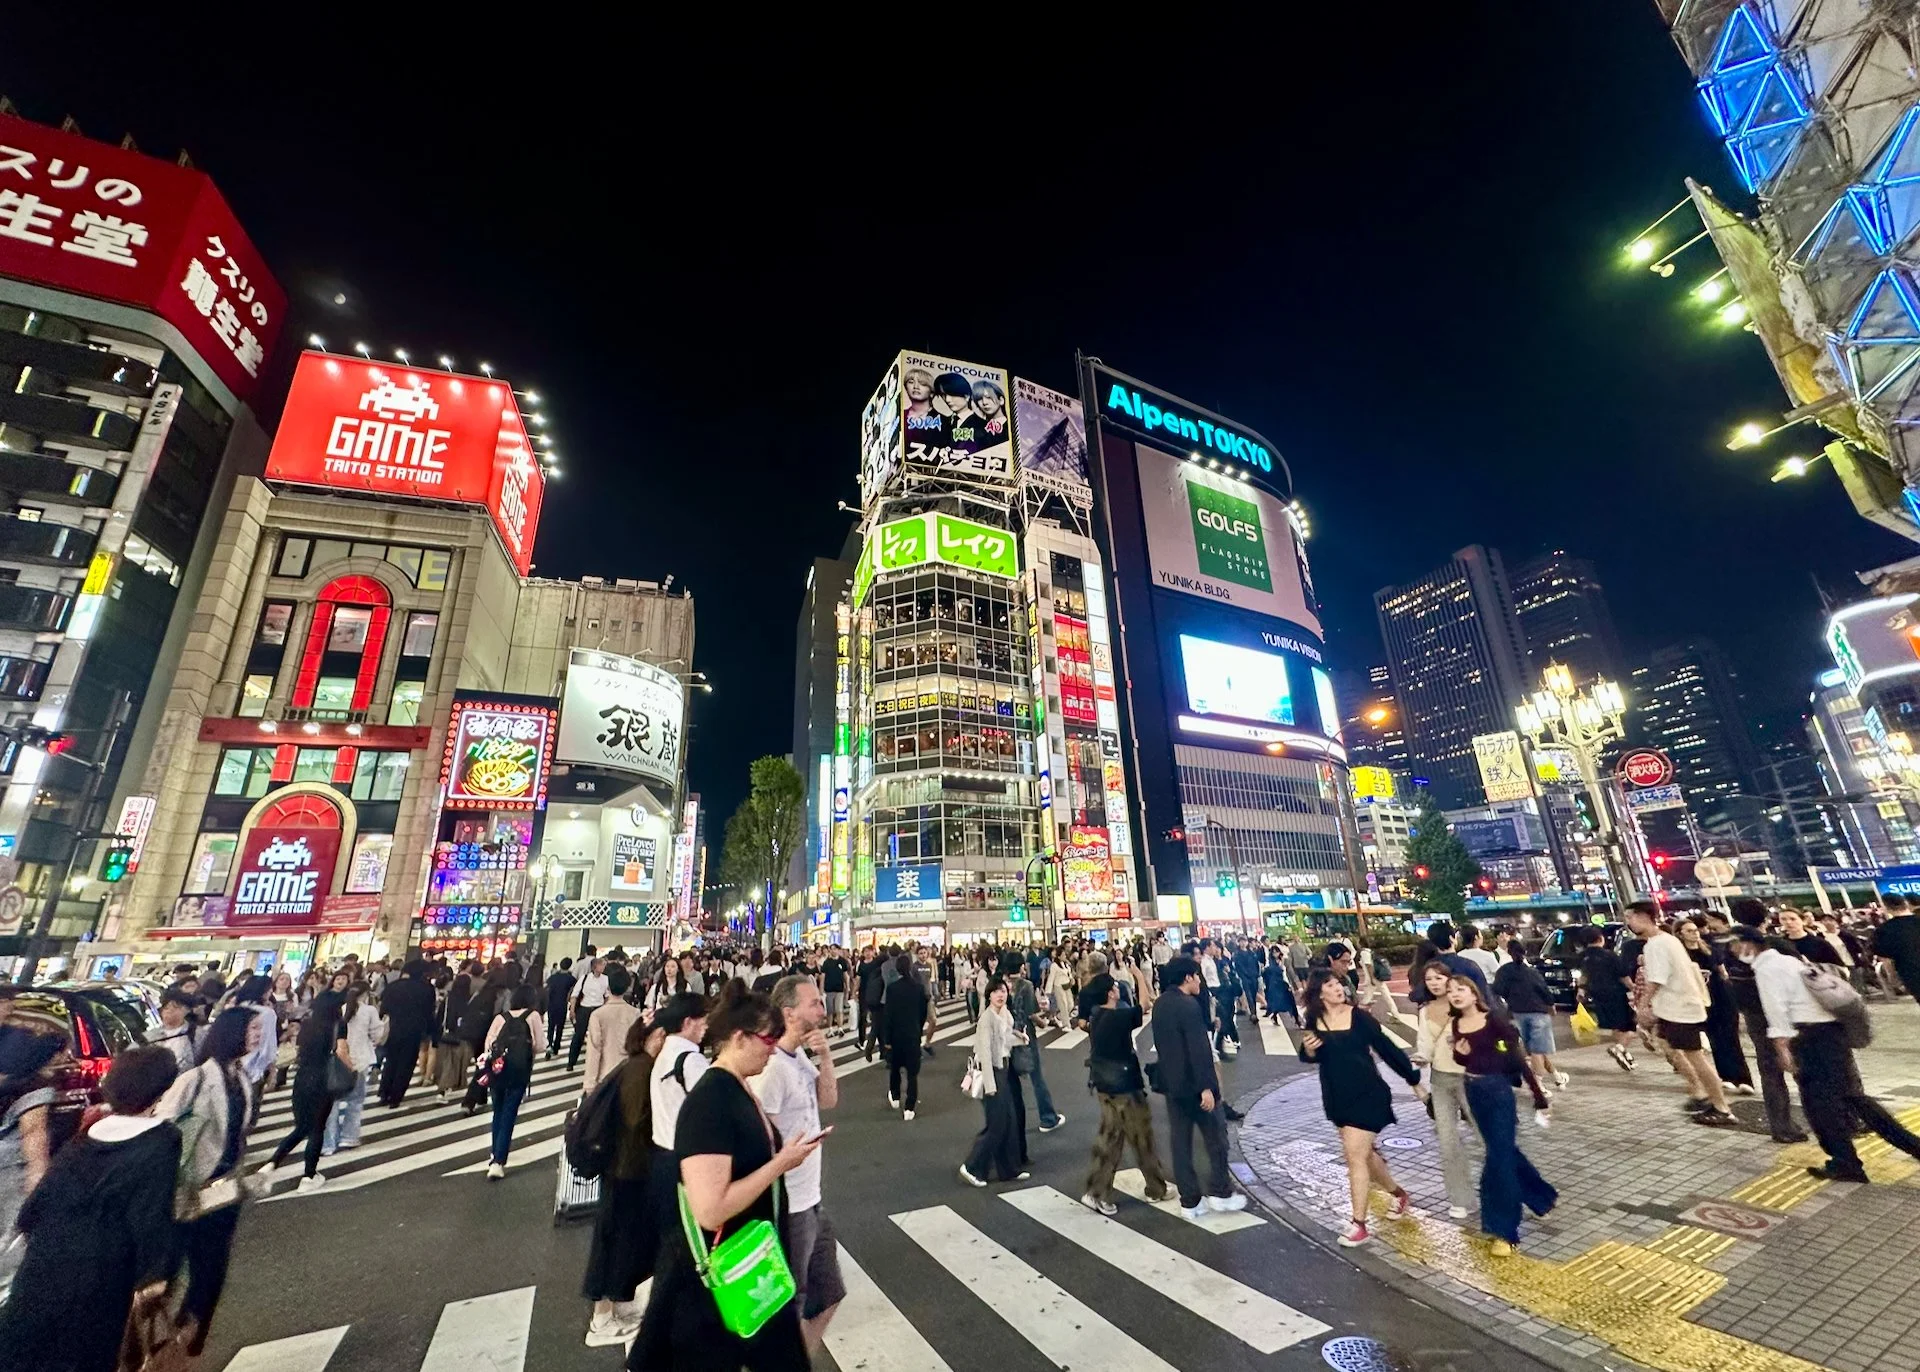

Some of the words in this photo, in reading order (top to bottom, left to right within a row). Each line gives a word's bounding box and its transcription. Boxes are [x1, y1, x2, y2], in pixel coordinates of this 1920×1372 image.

[0, 188, 149, 268] 生堂
[206, 235, 268, 326] クスリの
[906, 356, 935, 369] SPICE
[937, 362, 1001, 382] CHOCOLATE
[326, 416, 451, 469] GAME
[1197, 420, 1272, 473] TOKYO
[324, 457, 371, 475] TAITO
[375, 464, 442, 485] STATION
[1196, 507, 1258, 542] GOLF5
[941, 523, 1006, 560] レイク
[1201, 542, 1264, 569] FLAGSHIP
[1227, 561, 1266, 580] STORE
[1158, 569, 1203, 592] YUNIKA
[1204, 583, 1233, 601] BLDG.
[1261, 631, 1300, 654] YUNIKA
[898, 697, 915, 709] 祝日
[1016, 704, 1028, 715] 6F
[1476, 737, 1516, 756] カラオケ
[602, 750, 660, 770] WATCHNIAN
[1495, 755, 1505, 765] の
[1628, 762, 1661, 778] 消火栓
[1370, 770, 1386, 781] プロ
[1486, 764, 1522, 782] 鉄人
[1374, 781, 1388, 793] ミス
[616, 835, 656, 850] PreLoved
[896, 869, 920, 899] 薬
[1290, 873, 1320, 887] TOKYO
[1824, 871, 1882, 881] SUBNADE
[236, 871, 319, 902] GAME
[1028, 888, 1043, 905] 薬
[234, 902, 265, 915] TAITO
[267, 902, 312, 914] STATION
